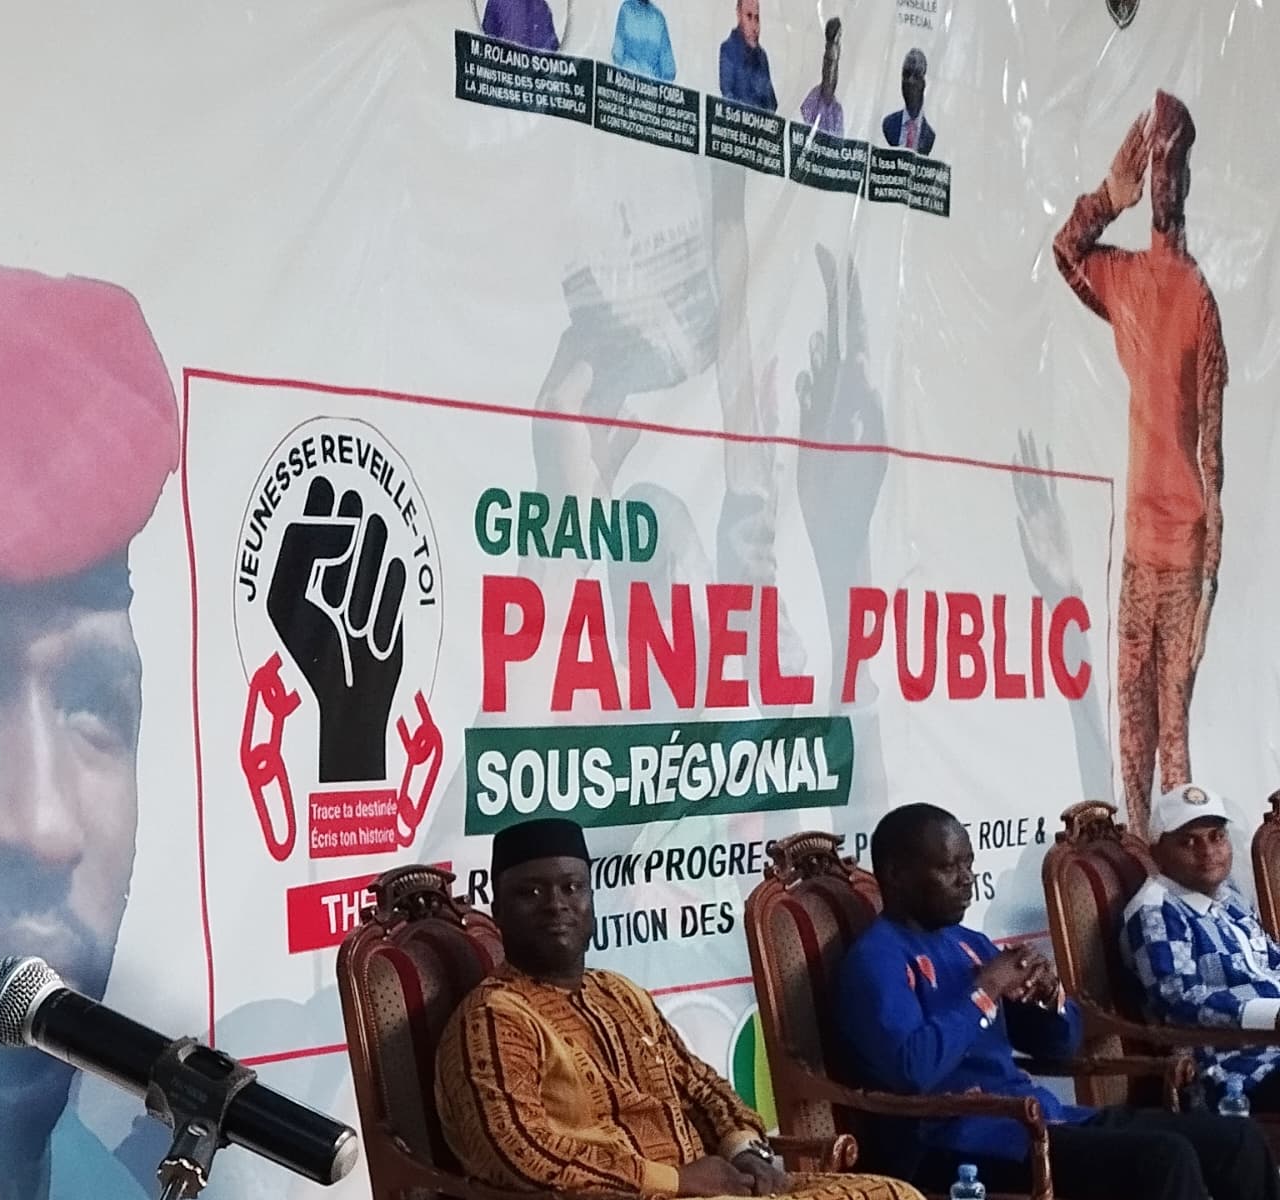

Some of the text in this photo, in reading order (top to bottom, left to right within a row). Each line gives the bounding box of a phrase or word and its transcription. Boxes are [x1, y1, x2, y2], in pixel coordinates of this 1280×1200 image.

[484, 44, 530, 69] ROLAND
[532, 55, 577, 76] SOMDA
[464, 61, 475, 76] LE
[514, 74, 534, 91] DES
[574, 84, 585, 97] DE
[465, 80, 476, 93] LA
[478, 82, 521, 102] JEUNESSE
[522, 91, 534, 105] ET
[536, 93, 549, 106] DE
[239, 434, 435, 606] JEUNESSE REVEILLE-TOI
[475, 488, 658, 563] GRAND
[482, 575, 1092, 712] PANEL PUBLIC
[477, 730, 839, 816] SOUS-RÉGIONAL
[311, 798, 398, 820] Trace ta destinée
[311, 826, 395, 849] Écris ton histoire
[979, 817, 1028, 850] ROLE
[1035, 816, 1046, 844] &
[681, 901, 735, 939] DES
